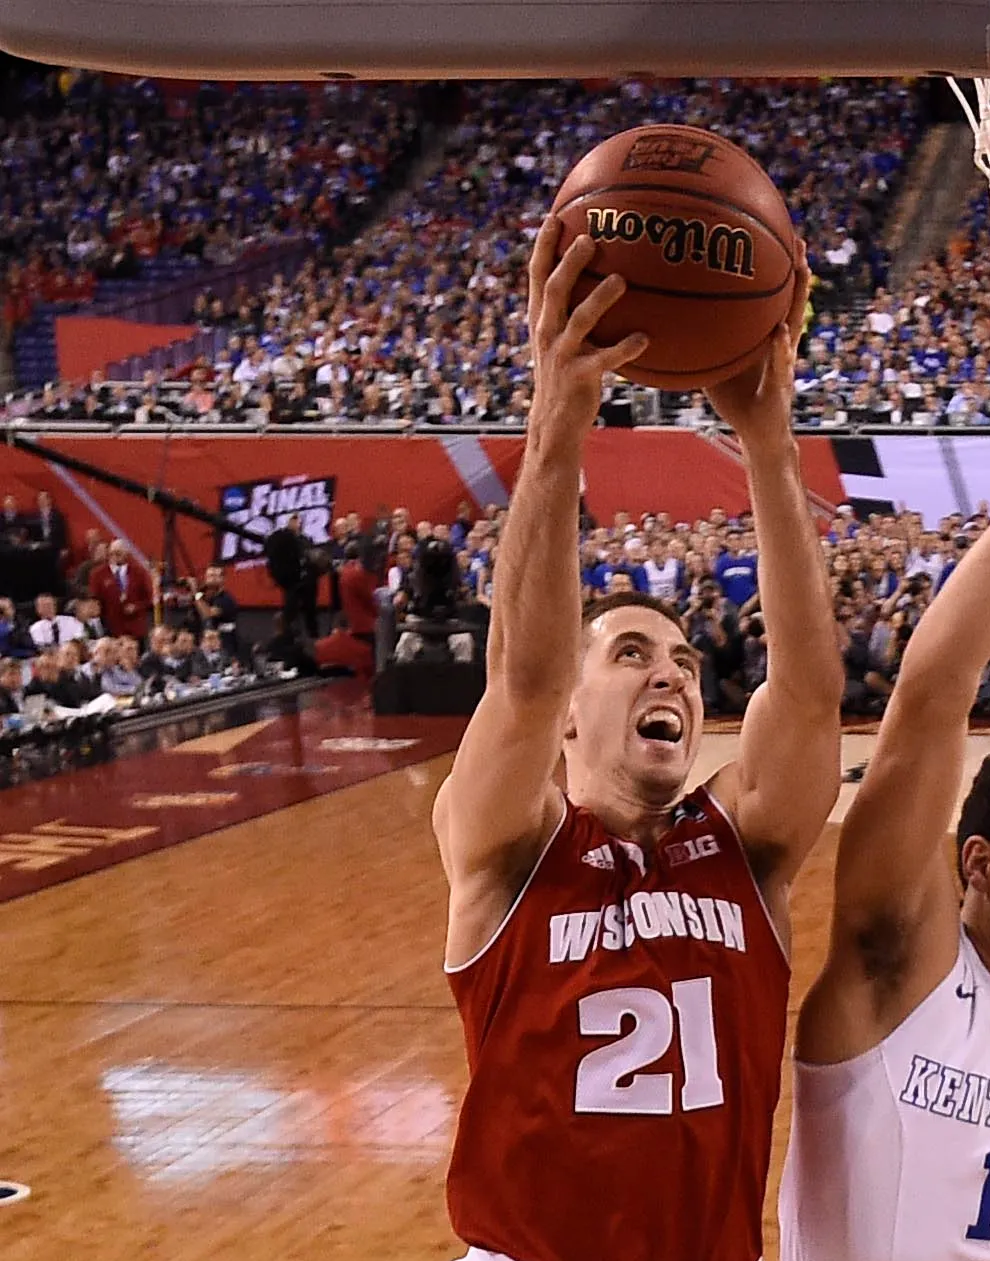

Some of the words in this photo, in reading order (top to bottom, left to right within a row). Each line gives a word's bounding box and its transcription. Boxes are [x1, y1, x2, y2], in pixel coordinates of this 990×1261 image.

[586, 208, 755, 281] Wilson
[549, 891, 747, 964] WSONSIN
[574, 976, 724, 1115] 21
